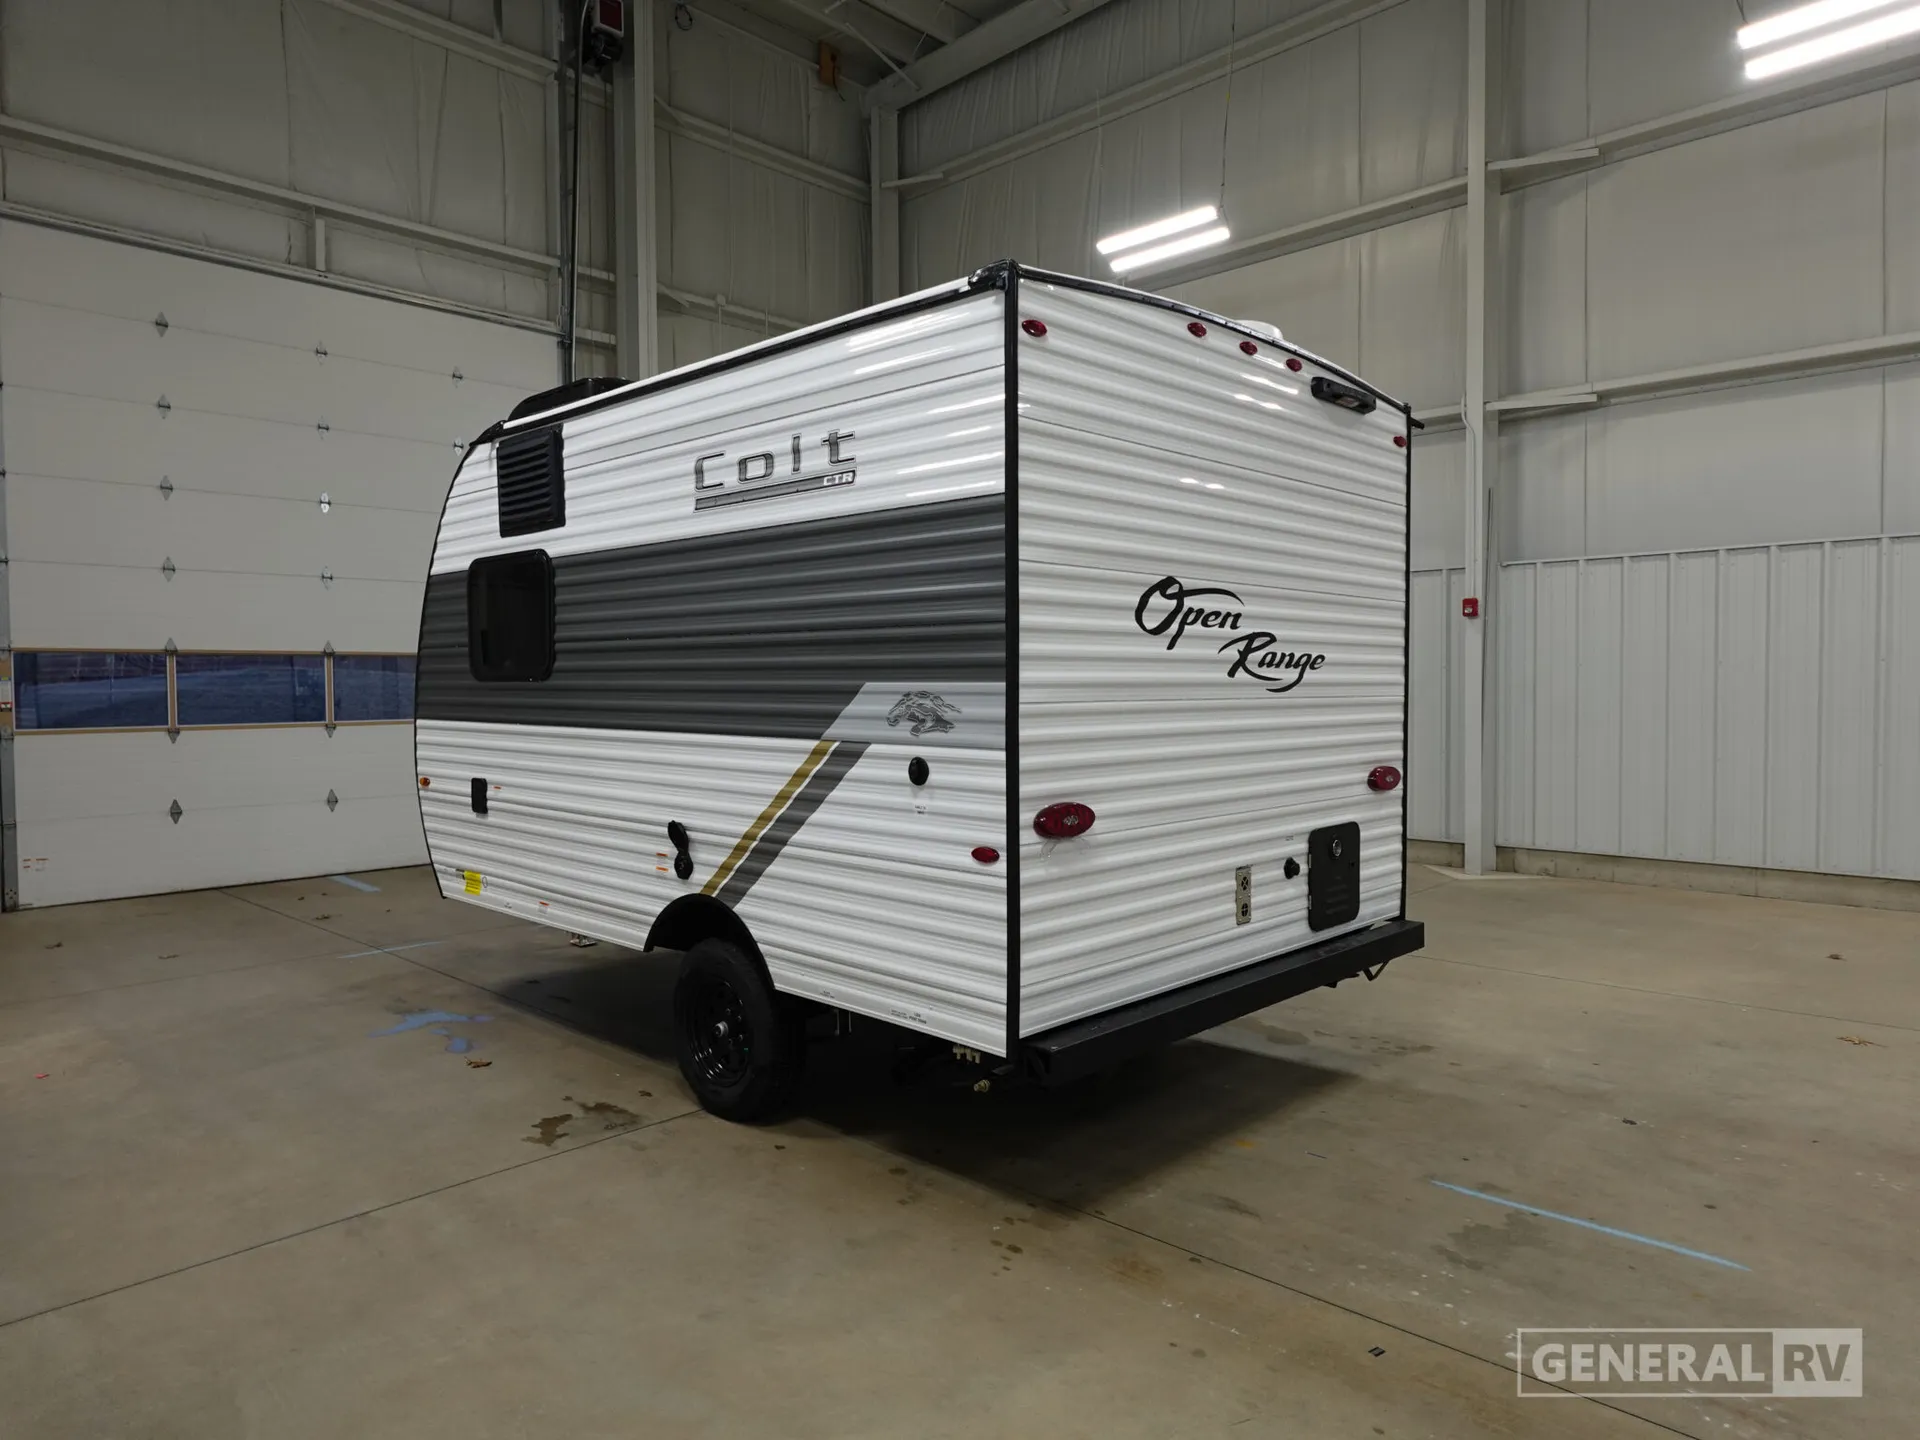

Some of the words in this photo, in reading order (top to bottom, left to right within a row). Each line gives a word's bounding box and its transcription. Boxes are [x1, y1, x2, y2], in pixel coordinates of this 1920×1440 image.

[694, 429, 857, 491] Colt
[823, 471, 854, 486] CTR
[1134, 575, 1245, 650] Open
[1217, 631, 1327, 693] Range
